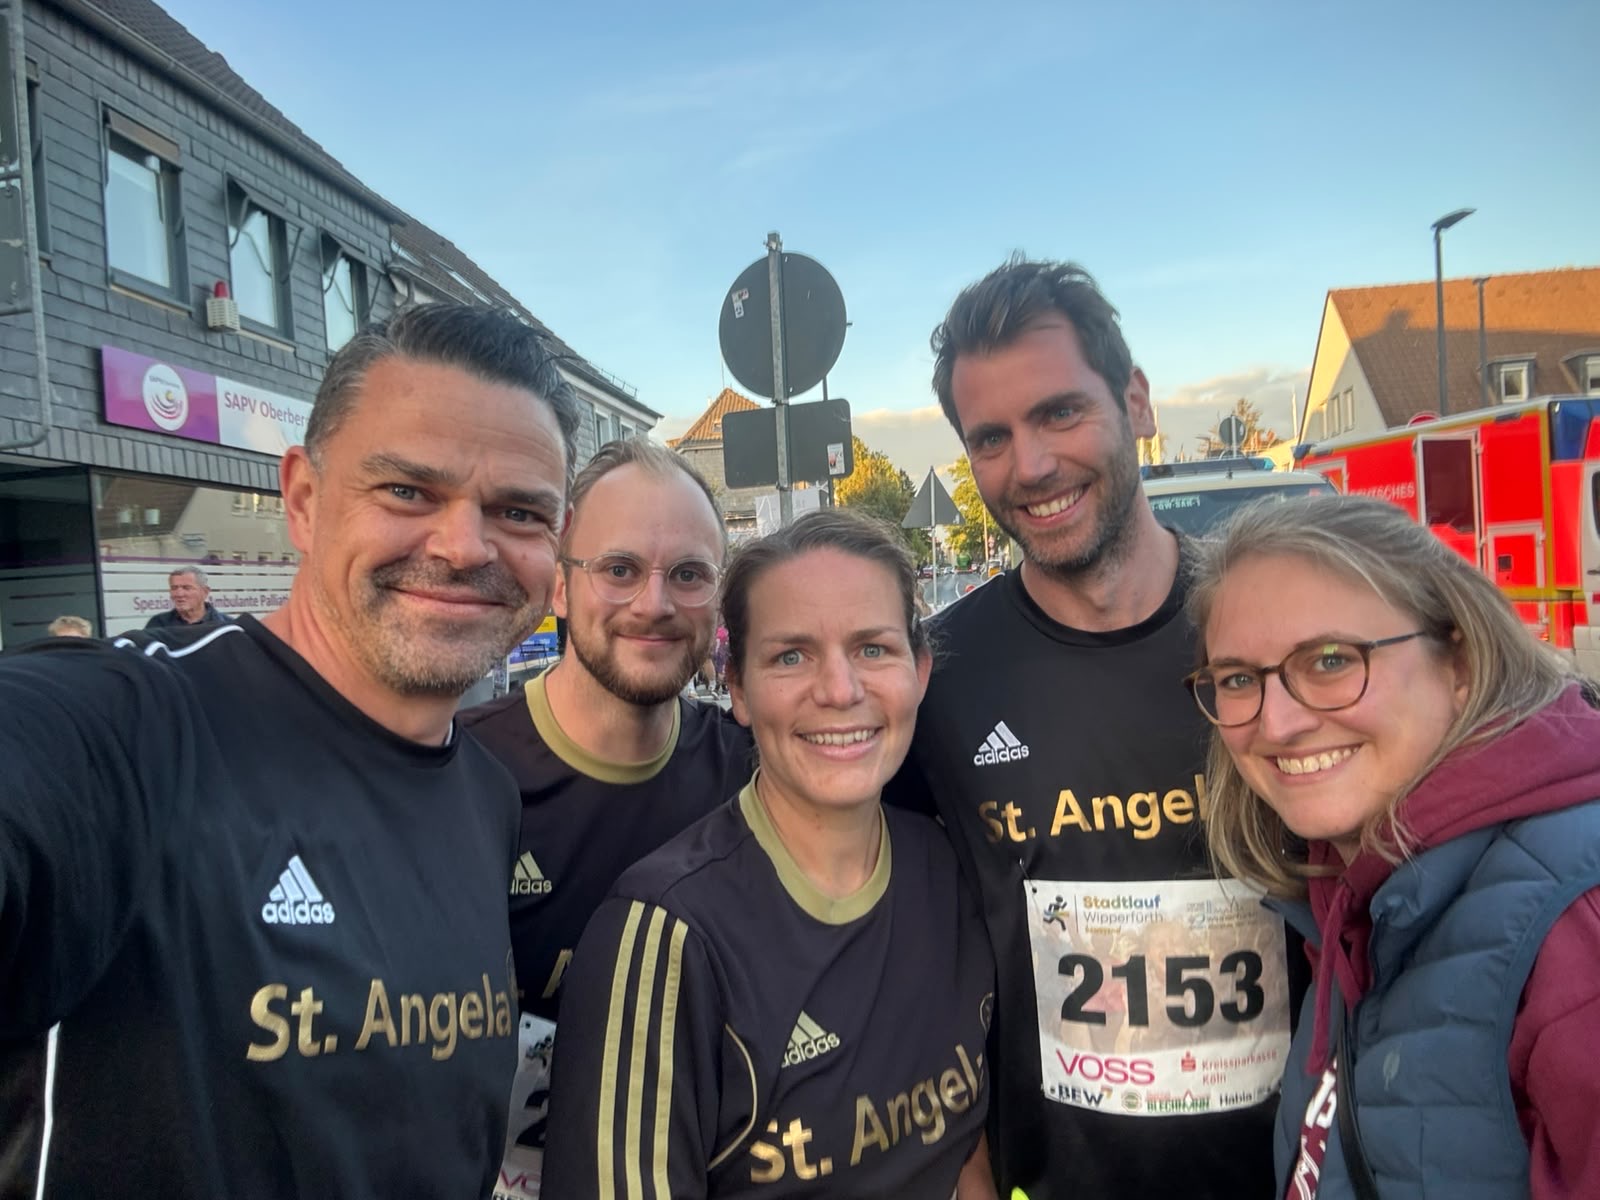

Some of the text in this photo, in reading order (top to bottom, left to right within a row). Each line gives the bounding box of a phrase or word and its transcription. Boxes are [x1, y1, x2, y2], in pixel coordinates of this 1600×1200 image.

[224, 391, 257, 414] SAPV
[973, 745, 1030, 766] adidas
[978, 774, 1208, 843] St. Angel
[261, 899, 336, 925] adidas
[1083, 895, 1161, 909] Stadtlauf
[1083, 910, 1164, 924] Wipperfürth
[1058, 951, 1264, 1028] 2153
[246, 983, 338, 1061] St.
[354, 973, 512, 1061] Angela
[1056, 1049, 1278, 1085] VOSS Kreissparkasse
[1202, 1073, 1227, 1085] Köln
[851, 1044, 985, 1167] Angel
[1057, 1084, 1104, 1107] BEW
